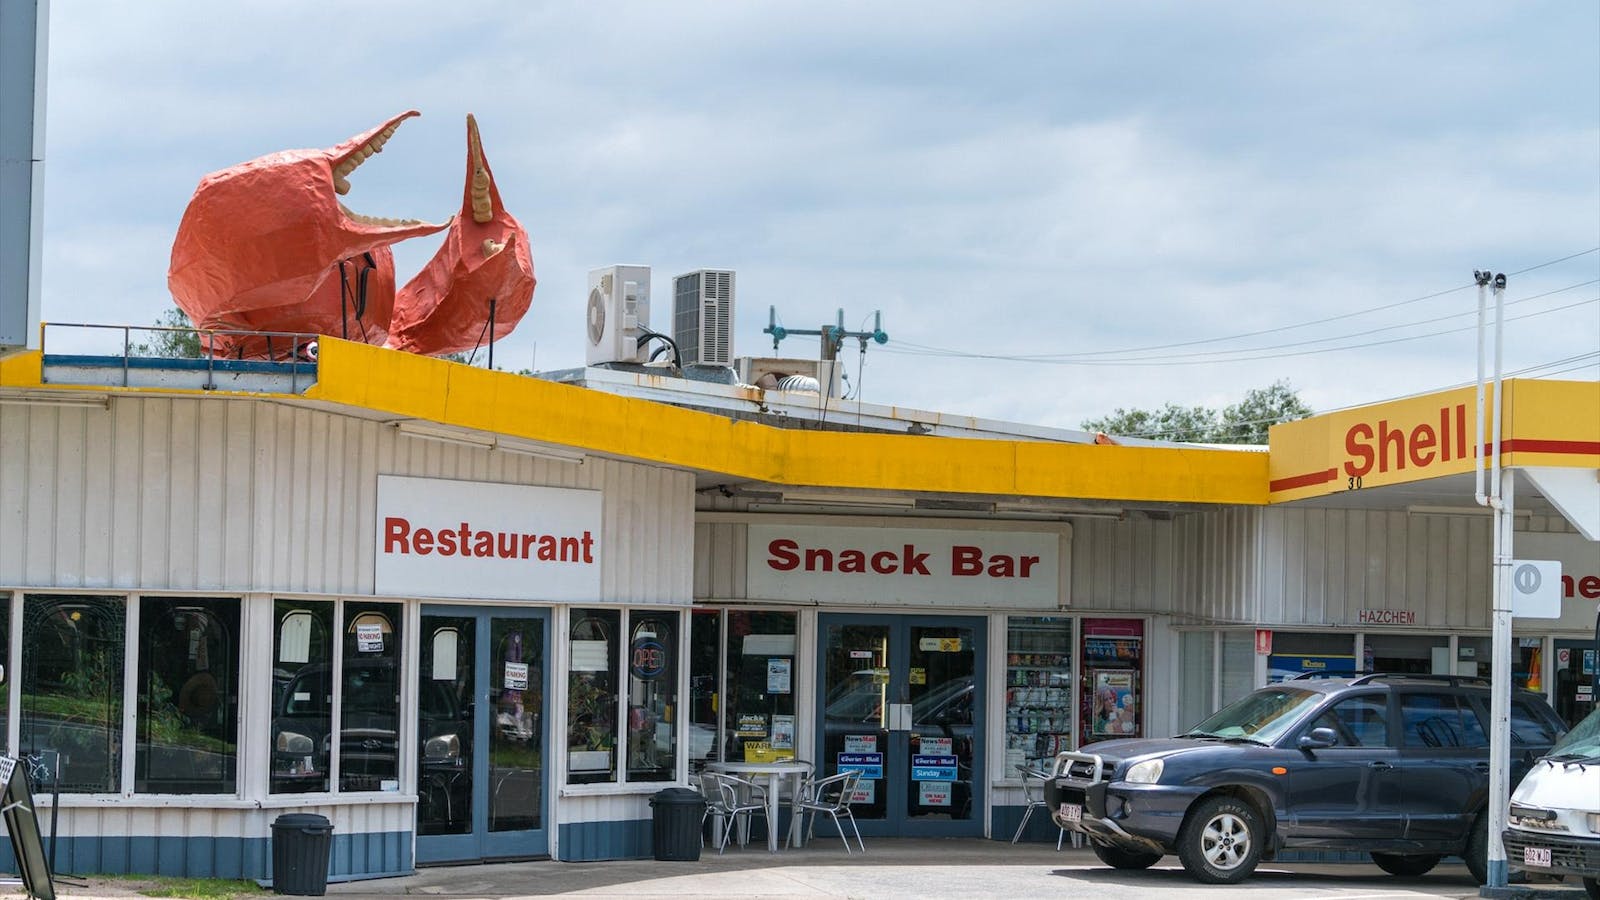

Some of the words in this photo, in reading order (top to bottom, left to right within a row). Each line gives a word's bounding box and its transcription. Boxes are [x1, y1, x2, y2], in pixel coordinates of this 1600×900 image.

[1344, 404, 1466, 477] Shell
[1348, 476, 1362, 490] 30
[384, 517, 594, 564] Restaurant
[767, 539, 931, 575] Snack
[952, 546, 1040, 578] Bar
[1359, 610, 1415, 624] HAZCHEM
